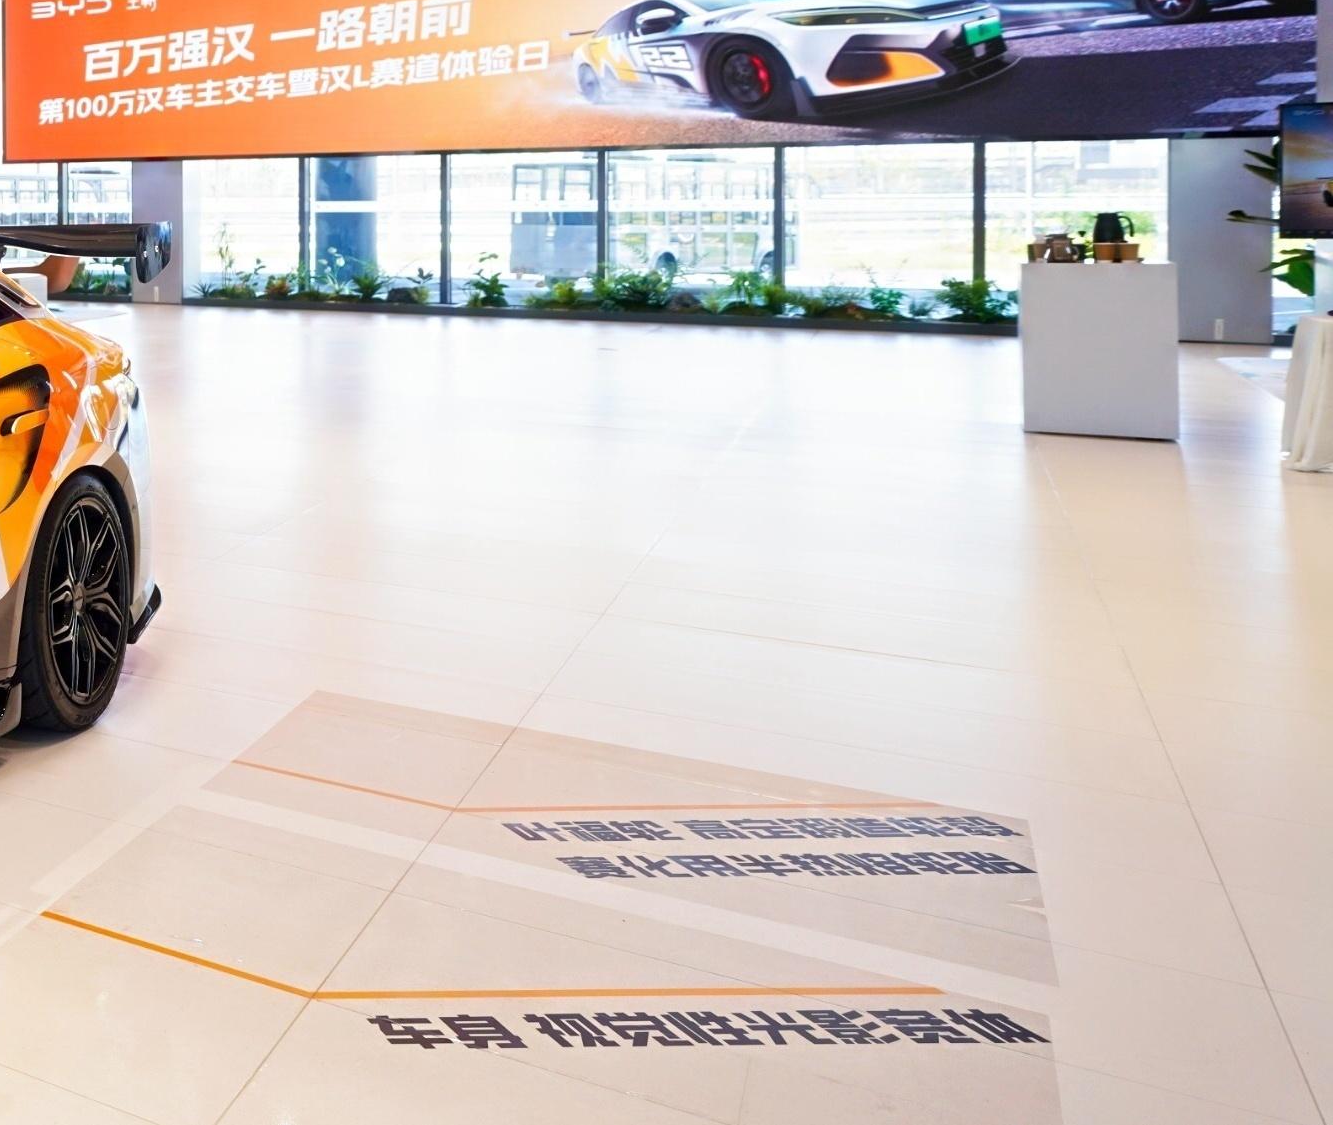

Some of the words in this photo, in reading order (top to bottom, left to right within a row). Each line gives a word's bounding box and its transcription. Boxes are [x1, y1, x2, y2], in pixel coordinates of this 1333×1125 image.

[83, 23, 255, 83] 百万强汉
[37, 40, 550, 124] 第100万汉车主交车暨汉L赛道体验日
[502, 820, 684, 842] 叶福轮
[673, 816, 1024, 840] 高定锻造轮毂
[556, 851, 1038, 879] 赛化用半热熔轮胎
[367, 1014, 528, 1049] 车身
[522, 1008, 1053, 1047] 视觉性光影宽体
